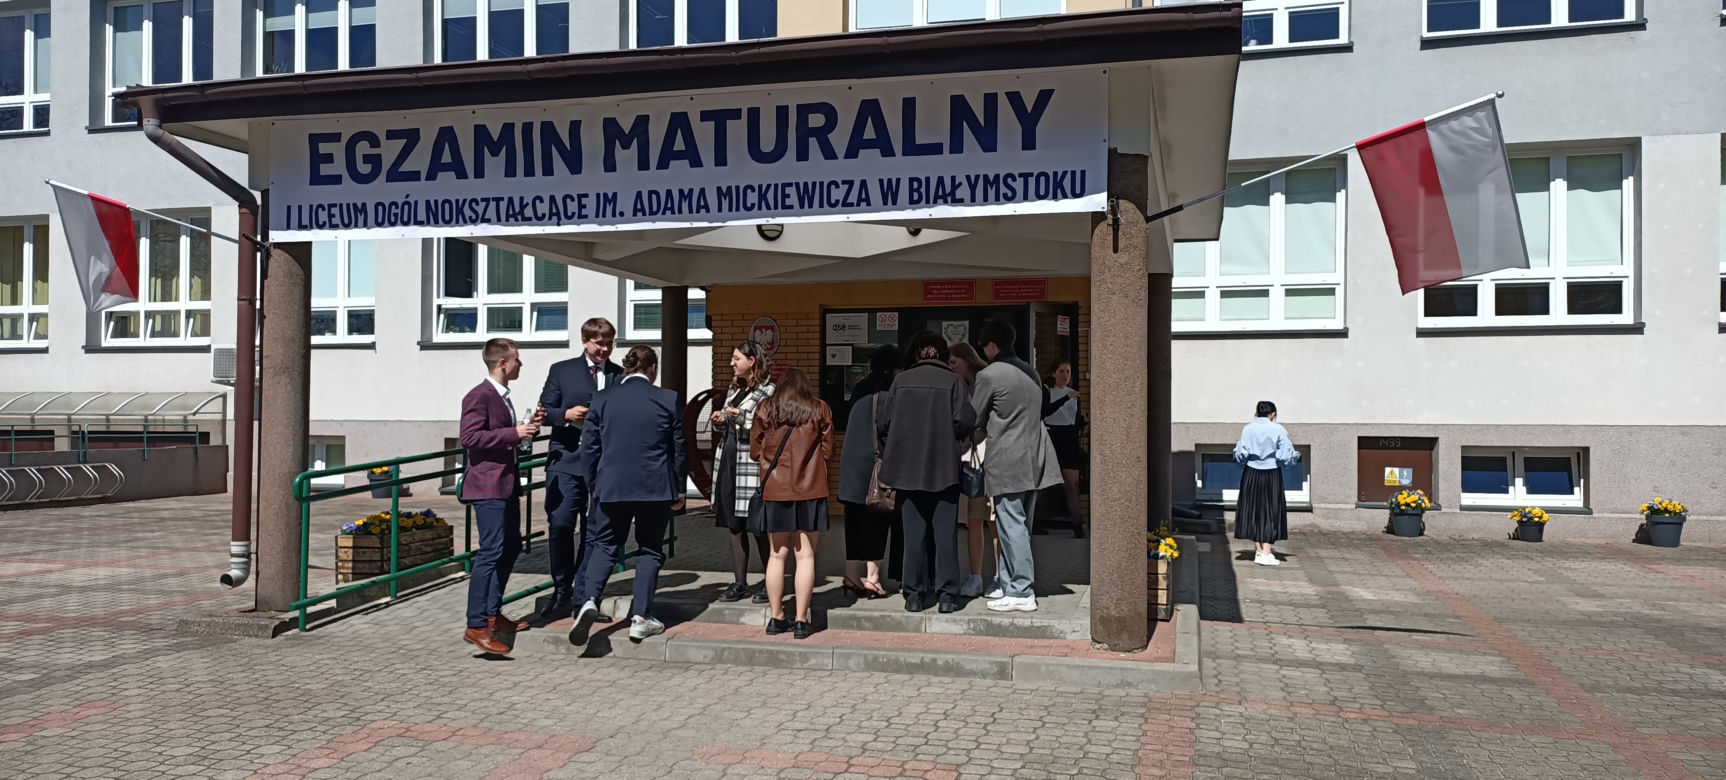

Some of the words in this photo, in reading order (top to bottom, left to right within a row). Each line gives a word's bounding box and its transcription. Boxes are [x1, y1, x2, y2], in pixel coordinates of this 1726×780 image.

[308, 119, 583, 186] EGZAMIN
[602, 88, 1055, 173] MATURALNY
[286, 205, 291, 230] I
[297, 202, 368, 230] LICEUM
[374, 193, 588, 228] OGÓLNOKSZTAŁCĄCE
[595, 191, 624, 219] IM.
[632, 186, 710, 217] ADAMA
[717, 177, 871, 213] MICKIEWICZA
[878, 177, 901, 206] W
[908, 169, 1087, 205] BIAŁYMSTOKU
